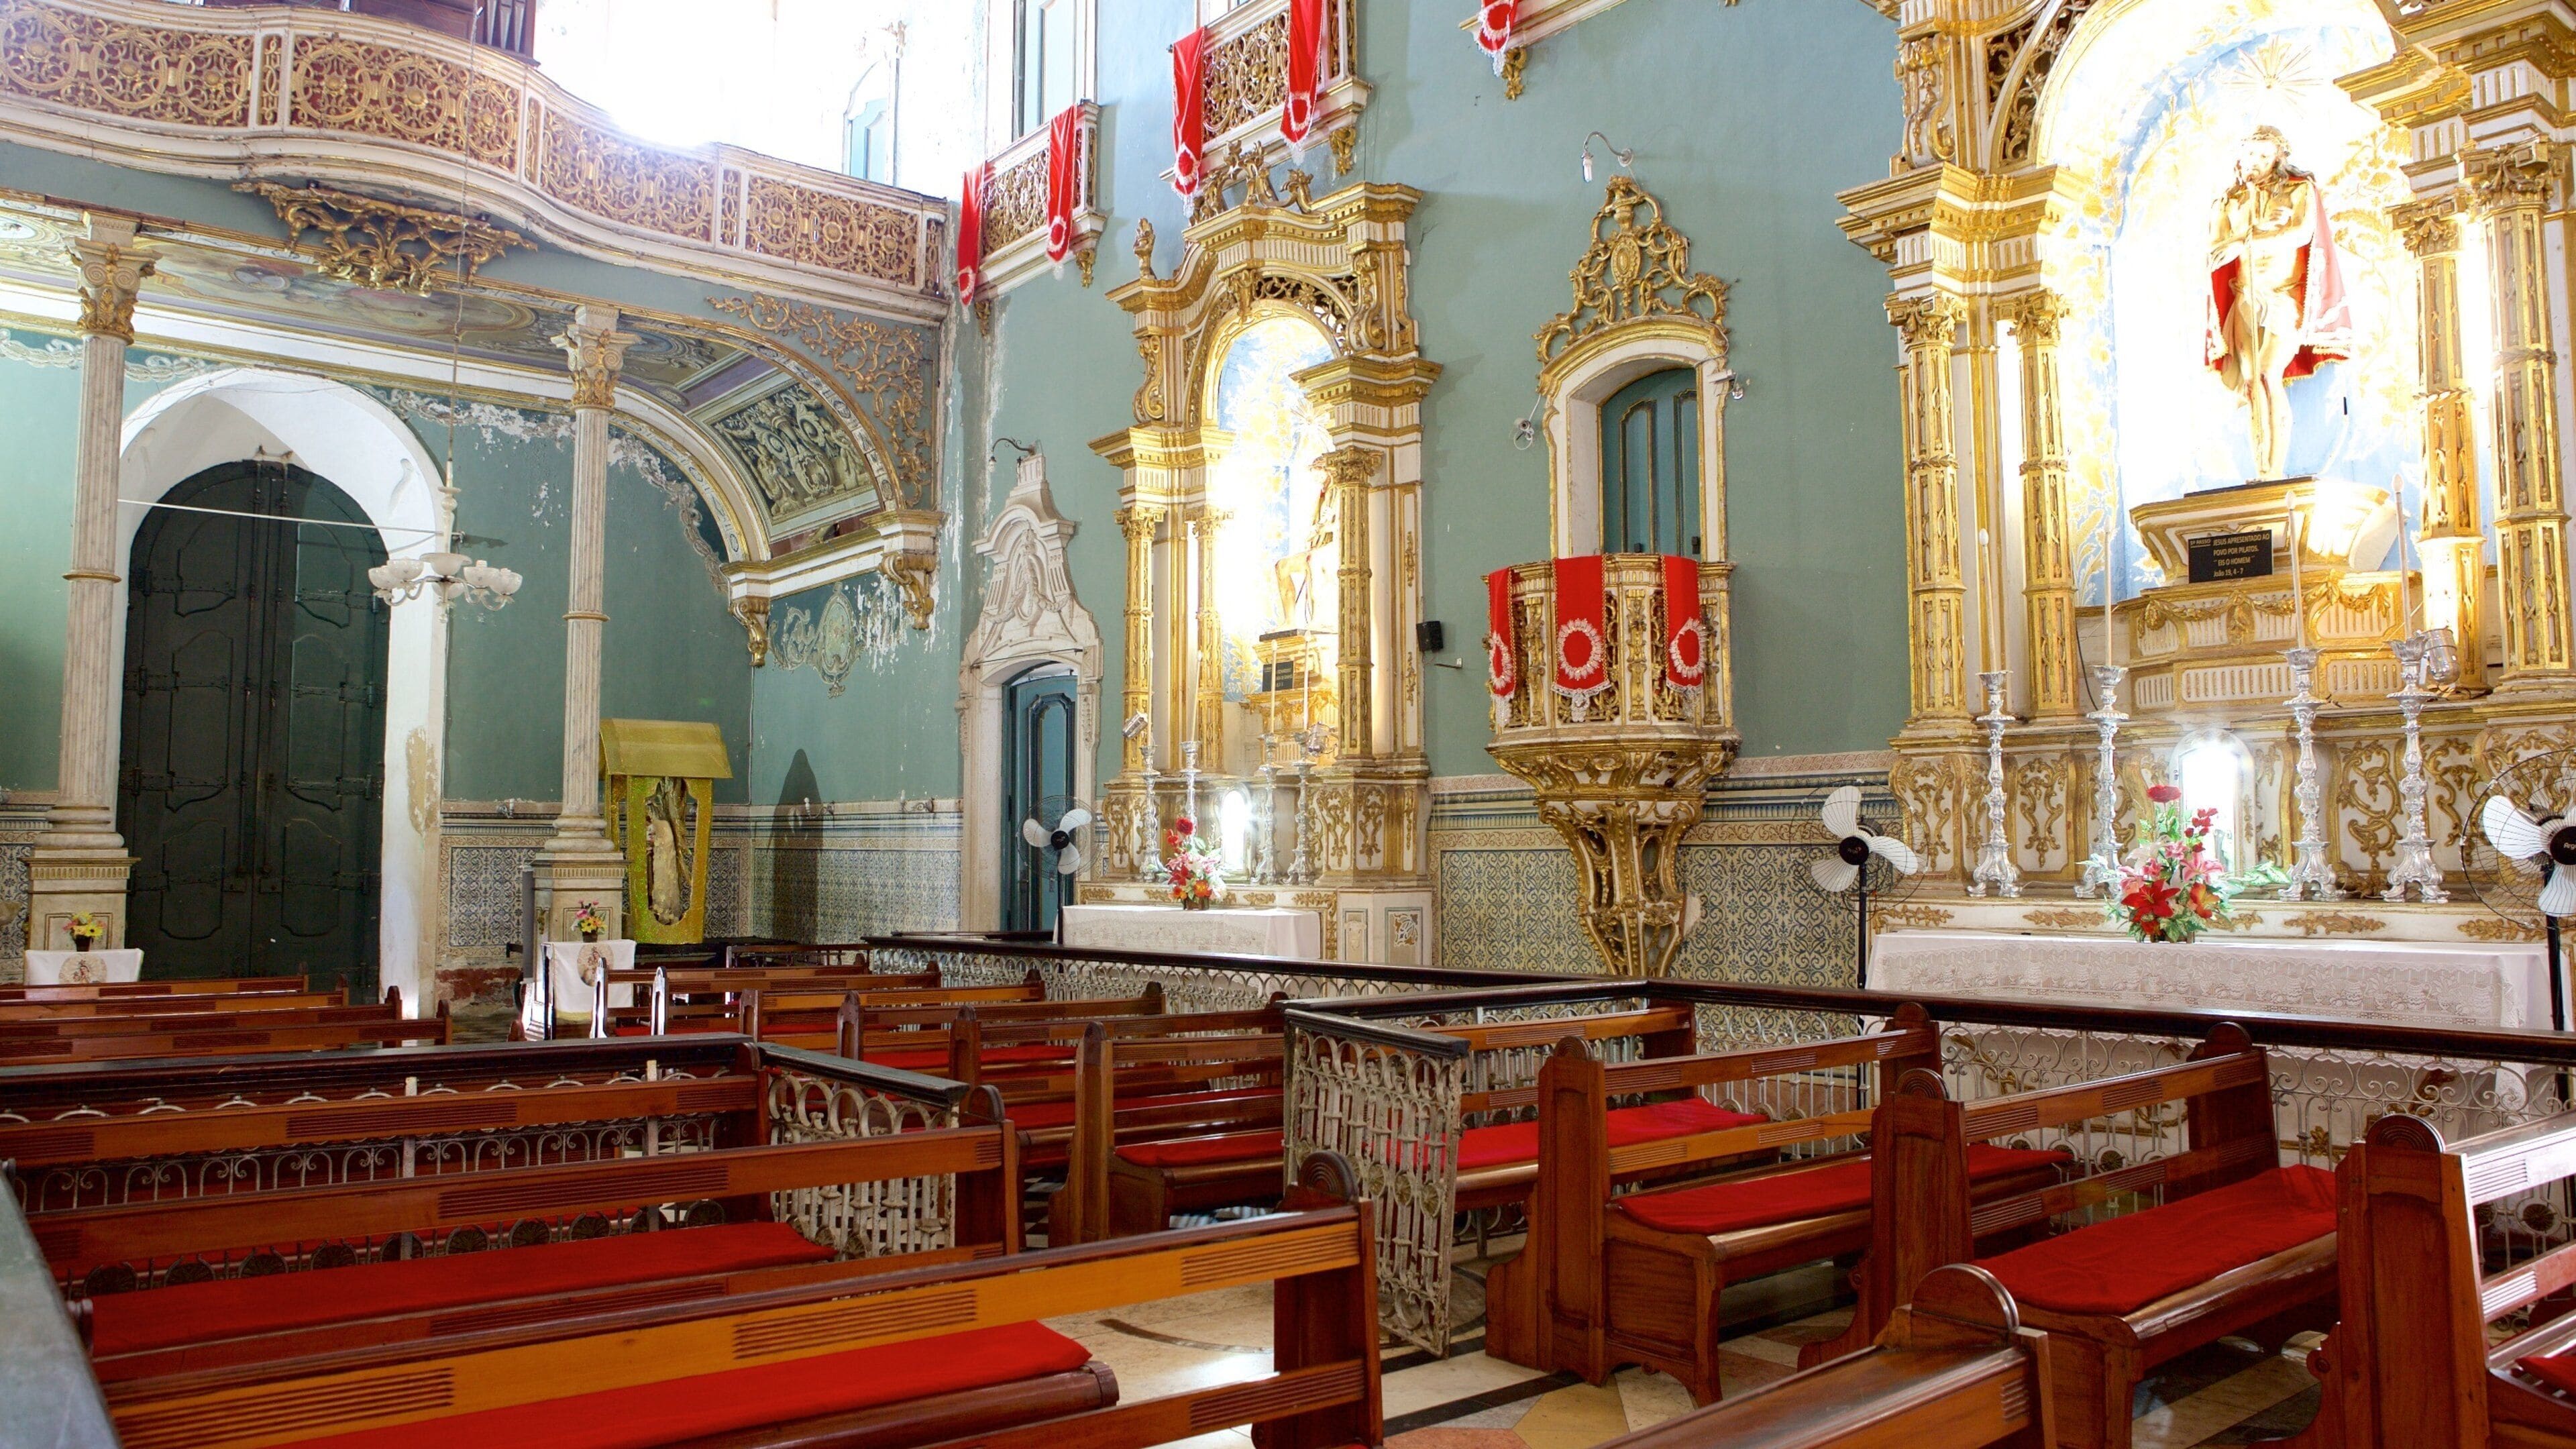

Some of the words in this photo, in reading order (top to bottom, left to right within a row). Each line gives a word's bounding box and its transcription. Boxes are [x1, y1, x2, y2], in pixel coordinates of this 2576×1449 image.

[2213, 538, 2226, 546] JESUS
[2227, 535, 2262, 544] APRESENTADO
[2213, 549, 2227, 557] POVO
[2227, 547, 2238, 555] POR
[2213, 570, 2224, 578] João
